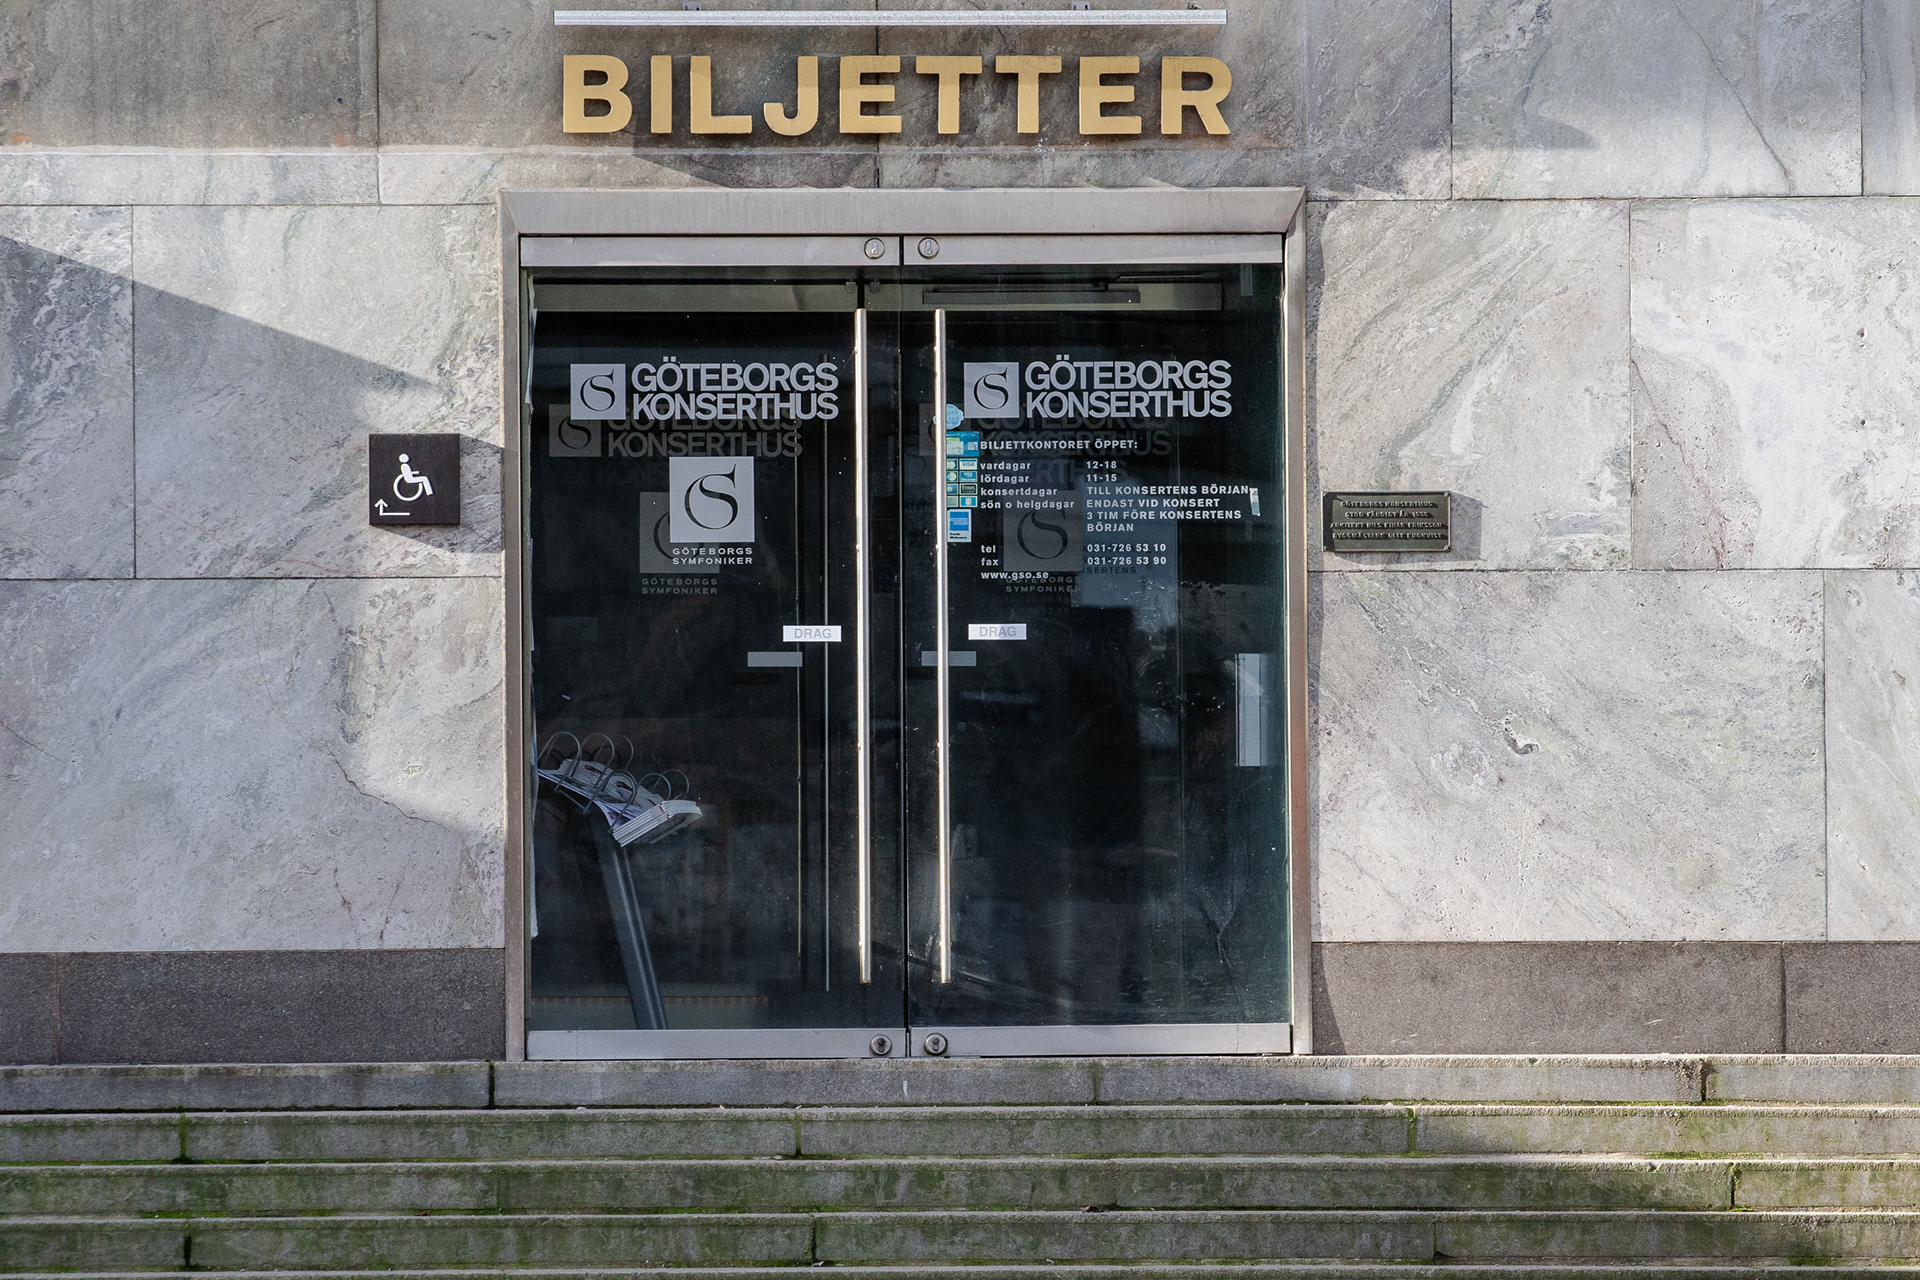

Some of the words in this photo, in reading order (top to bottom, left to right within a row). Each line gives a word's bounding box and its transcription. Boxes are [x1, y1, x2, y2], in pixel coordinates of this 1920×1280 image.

[563, 54, 1232, 136] BILJETTER
[631, 356, 839, 392] GÖTEBORGS
[1025, 354, 1232, 390] GÖTEBORGS
[633, 393, 839, 420] KONSERTHUS
[1026, 390, 1232, 418] KONSERTHUS
[980, 441, 1090, 450] BILJETTKONTORET
[1094, 439, 1138, 449] ÖPPET:
[980, 461, 1031, 471] vardagar
[1086, 460, 1117, 469] 12-18
[980, 474, 1029, 484] lördagar
[1086, 473, 1117, 482] 11-15
[980, 487, 1057, 497] konsertdagar
[1087, 486, 1111, 495] TILL
[1115, 485, 1197, 494] KONSERTENS
[1201, 484, 1249, 494] BÖRJAN
[980, 500, 1001, 509] sön
[1016, 500, 1075, 510] helgdagar
[1086, 499, 1134, 508] ENDAST
[1138, 499, 1158, 507] VID
[1163, 499, 1220, 507] KONSERT
[1340, 499, 1382, 507] GÖTEBORGS
[1086, 512, 1093, 520] 3
[1098, 511, 1118, 519] TIM
[1123, 509, 1155, 519] FÖRE
[1160, 510, 1242, 519] KONSERTENS
[1087, 522, 1134, 532] BÖRJAN
[672, 547, 753, 556] GÖTEBORGS
[981, 544, 996, 553] tel
[1087, 543, 1132, 552] 031-726
[1135, 543, 1149, 552] 53
[1153, 543, 1166, 552] 10
[981, 557, 999, 566] fax
[1087, 557, 1132, 565] 031-726
[1136, 557, 1149, 565] 53
[1153, 557, 1167, 565] 90
[981, 571, 1049, 581] www.gso.se
[794, 628, 832, 639] DRAG
[979, 626, 1017, 637] DRAG
